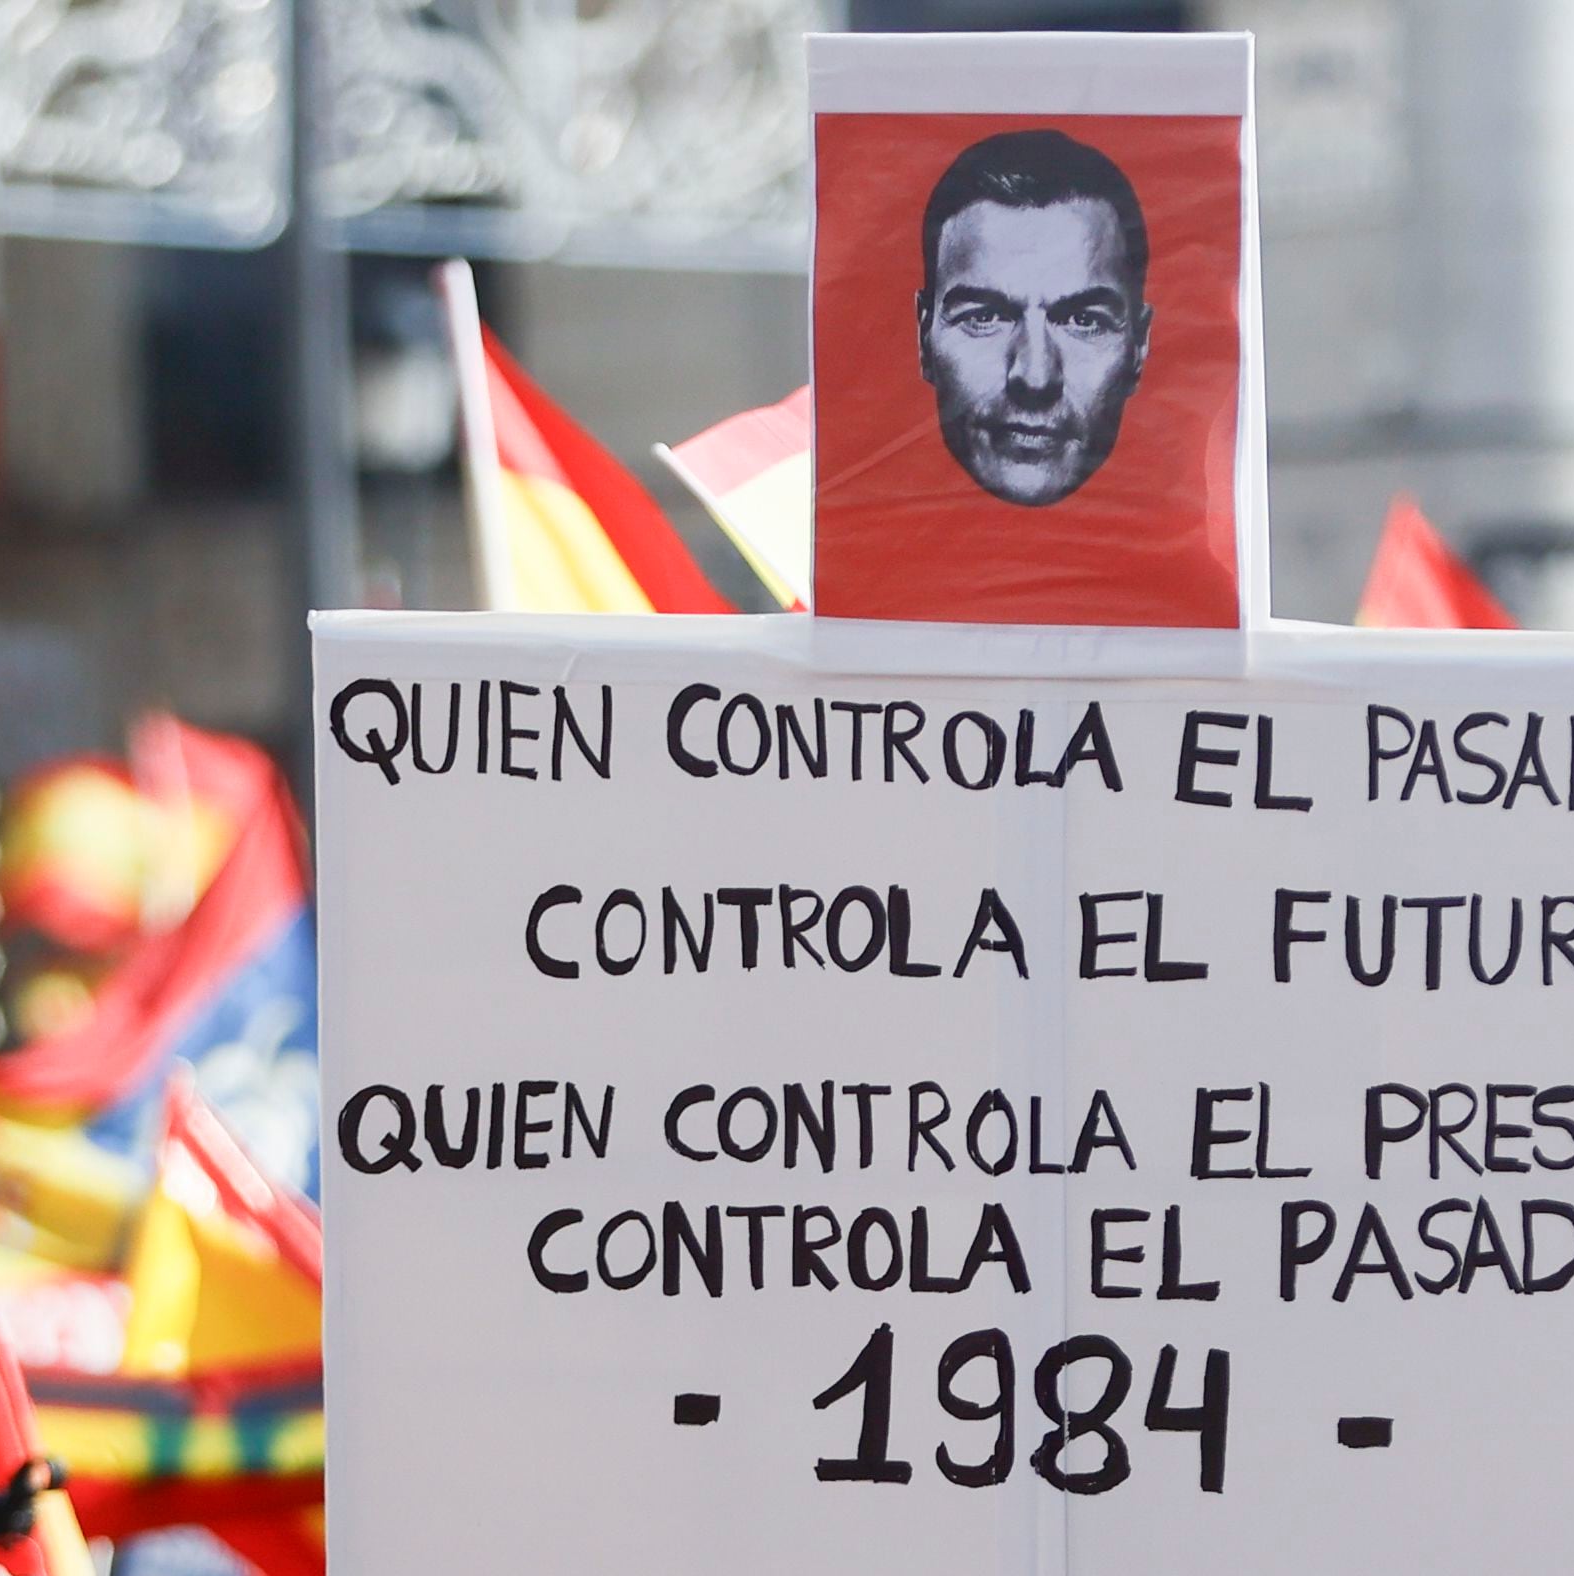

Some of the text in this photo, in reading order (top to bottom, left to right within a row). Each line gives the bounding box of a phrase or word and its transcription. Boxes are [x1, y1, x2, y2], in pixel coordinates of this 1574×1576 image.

[329, 677, 614, 787] QUIEN
[665, 681, 1125, 793] CONTROLA
[1173, 709, 1315, 813] EL
[524, 882, 1031, 981] CONTROLA
[1077, 889, 1210, 984] EL
[336, 1079, 616, 1176] QUIEN
[662, 1078, 1138, 1178] CONTROLA
[1189, 1080, 1314, 1182] EL
[525, 1199, 1033, 1300] CONTROLA
[1089, 1203, 1222, 1303] EL
[811, 1321, 1231, 1497] 1984
